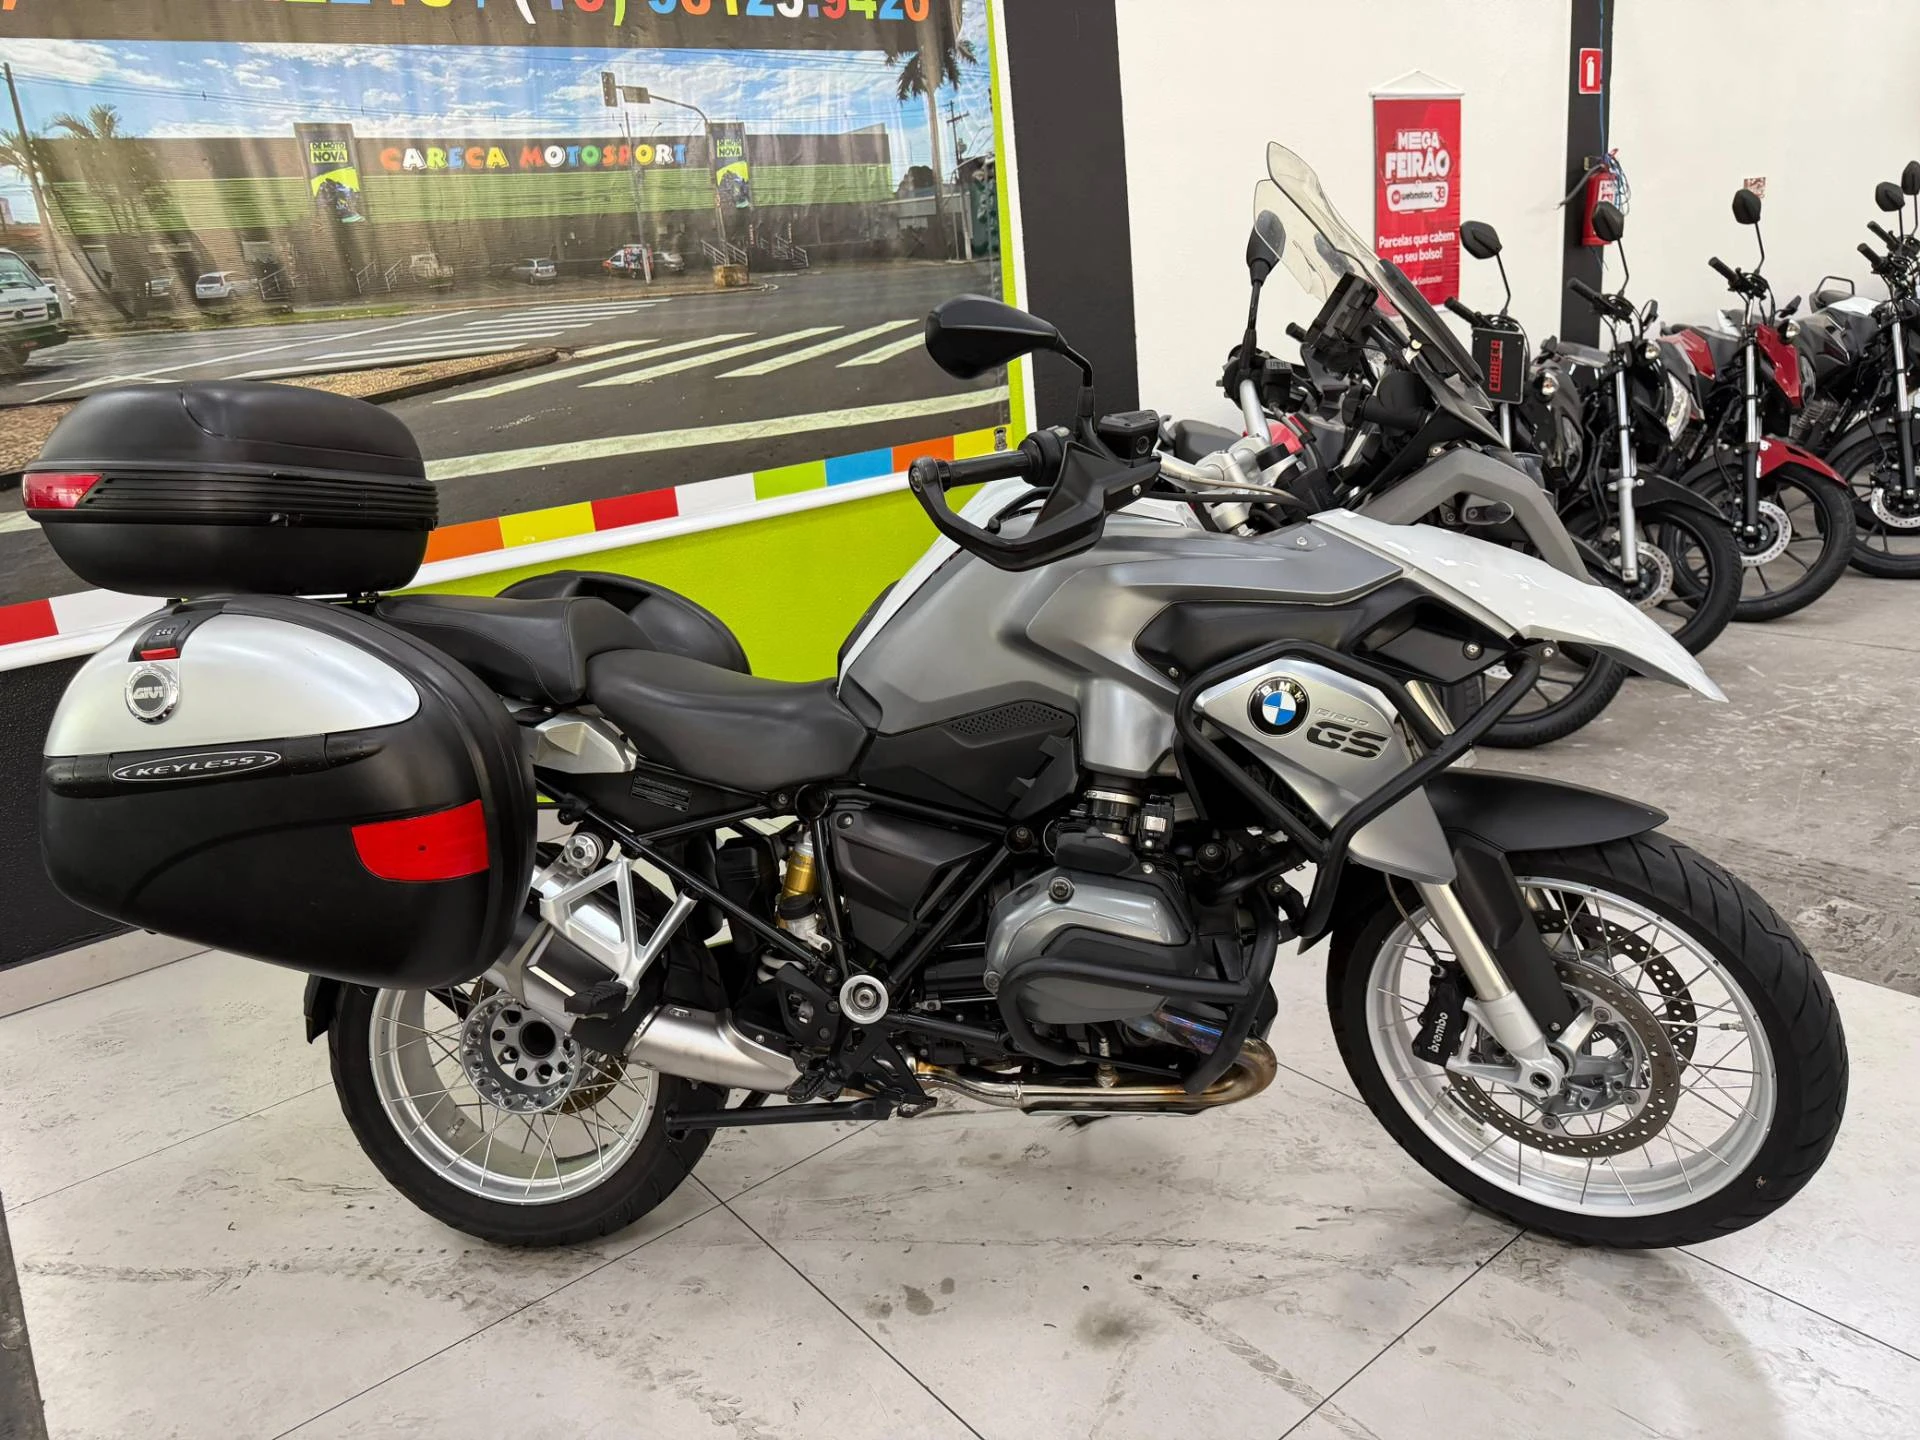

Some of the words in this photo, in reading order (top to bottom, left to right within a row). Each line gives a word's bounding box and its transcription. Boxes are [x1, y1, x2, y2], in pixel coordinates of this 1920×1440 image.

[1398, 131, 1440, 150] MEGA
[313, 151, 346, 162] NOVA
[379, 146, 510, 171] CARECA
[519, 144, 687, 169] MOTOSPORT
[719, 147, 741, 156] NOVA
[1385, 147, 1450, 179] FEIRÃO
[1379, 233, 1413, 249] Parcelas
[1413, 233, 1429, 248] que
[1429, 230, 1455, 244] cabem
[1393, 254, 1403, 265] no
[1404, 251, 1418, 263] seu
[1418, 246, 1443, 261] bolso!
[133, 685, 165, 700] GIVI
[1259, 680, 1306, 704] BMW
[1306, 721, 1388, 758] GS
[136, 755, 256, 777] KEYLESS
[1427, 1011, 1449, 1054] brembo
